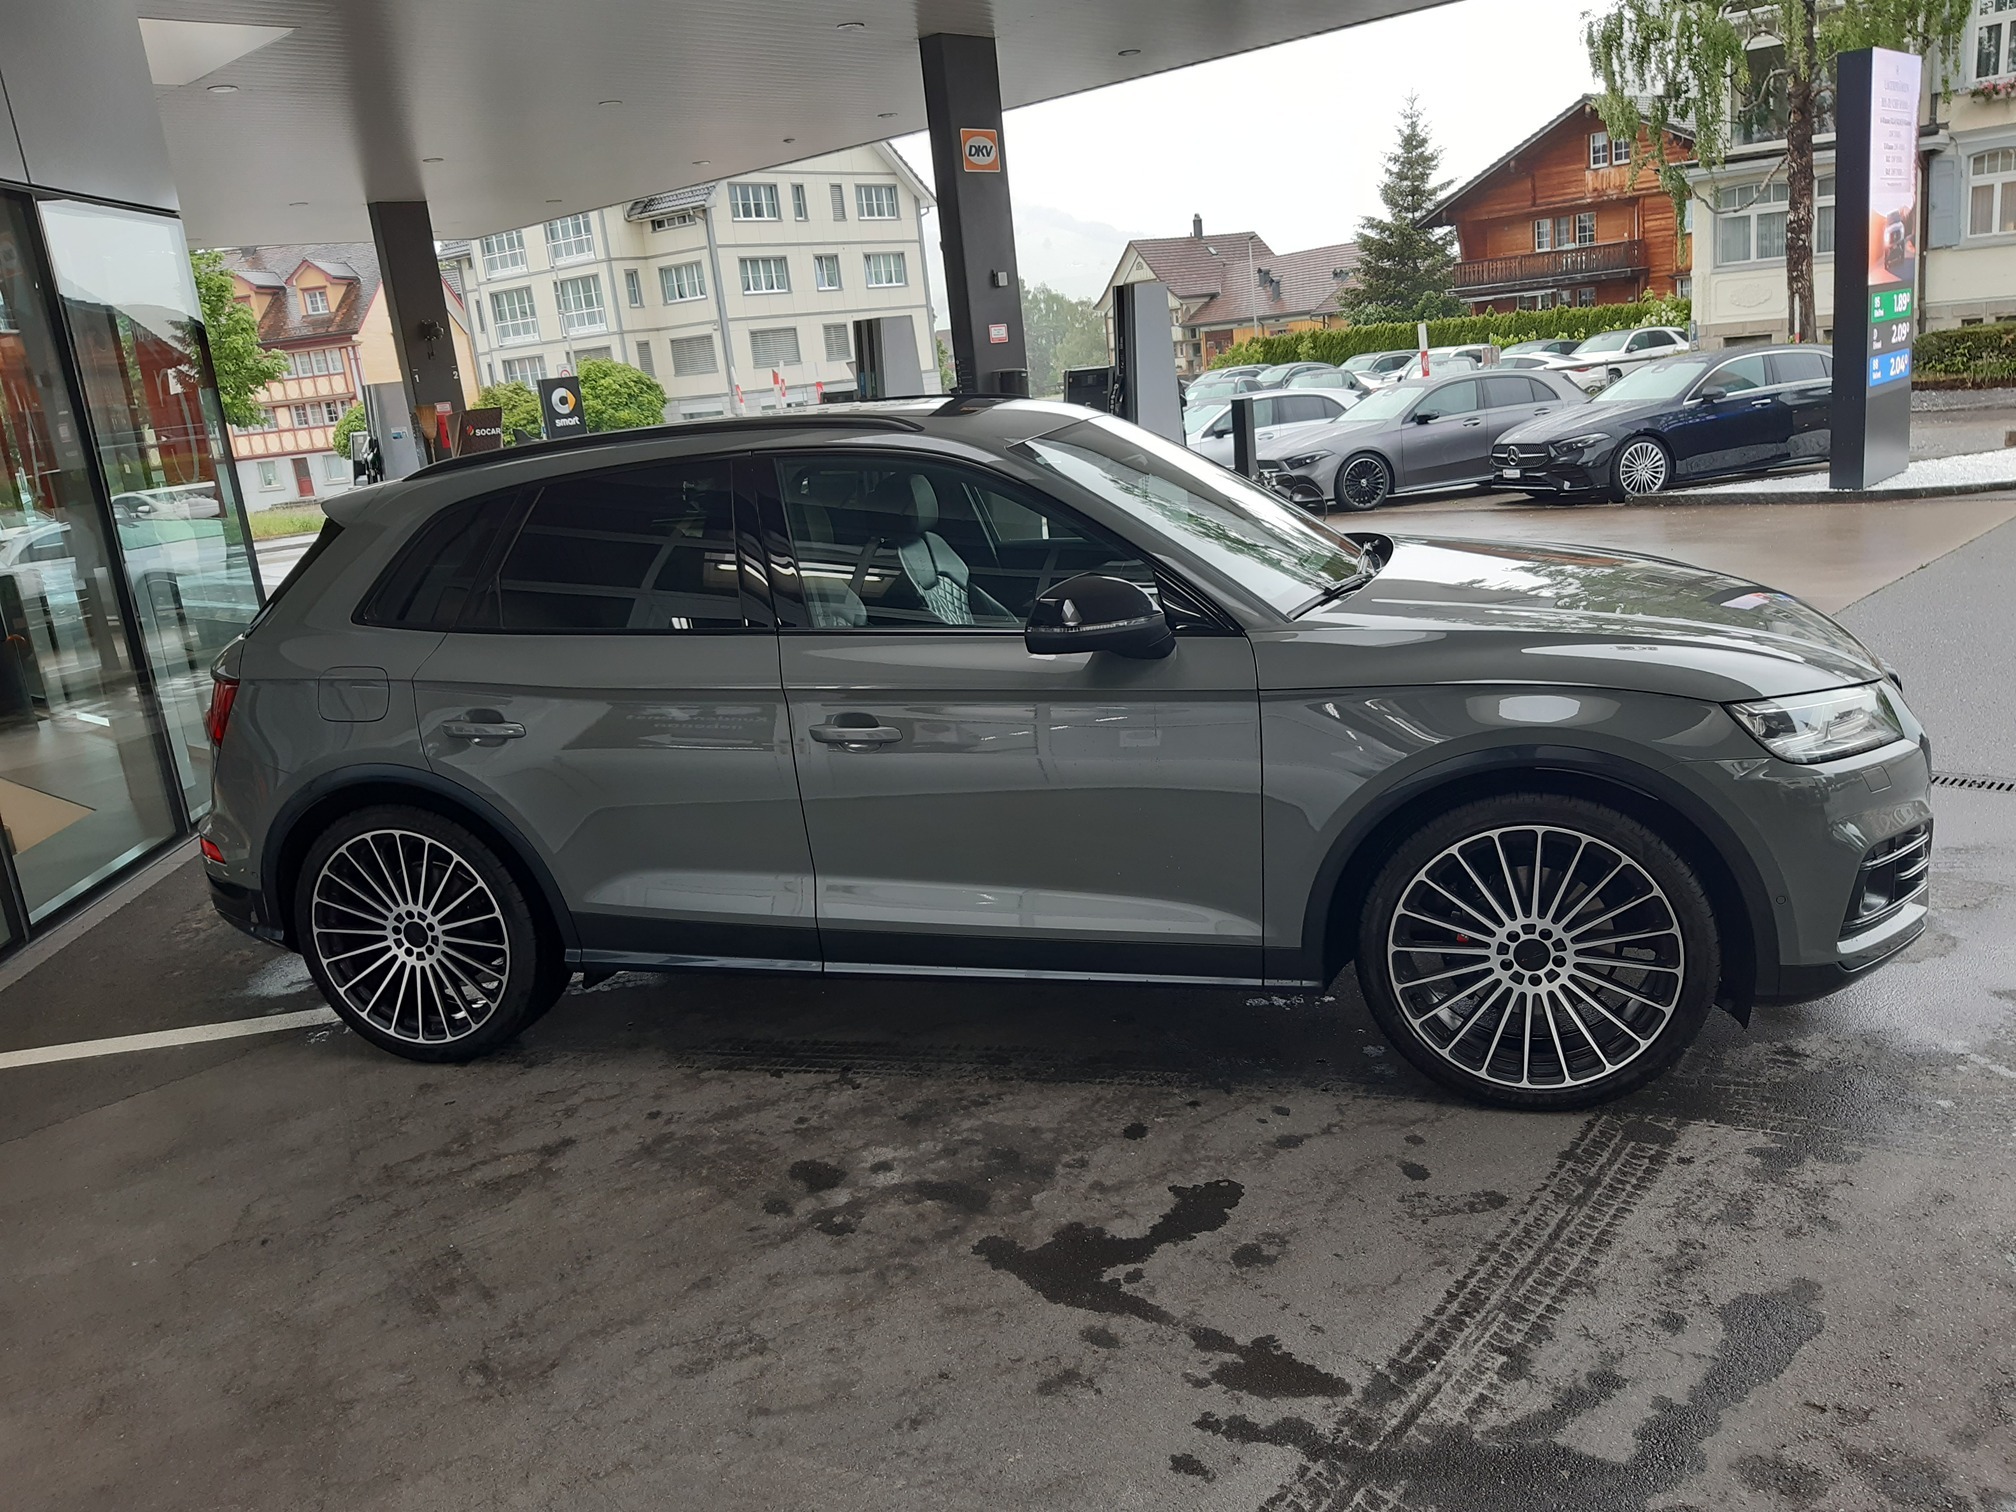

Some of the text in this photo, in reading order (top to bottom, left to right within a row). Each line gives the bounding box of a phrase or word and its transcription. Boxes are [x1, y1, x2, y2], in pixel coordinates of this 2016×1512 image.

[968, 144, 993, 157] DKV
[414, 374, 420, 383] 1
[452, 371, 459, 380] 2
[555, 416, 580, 427] smart
[475, 426, 501, 437] SOCAR
